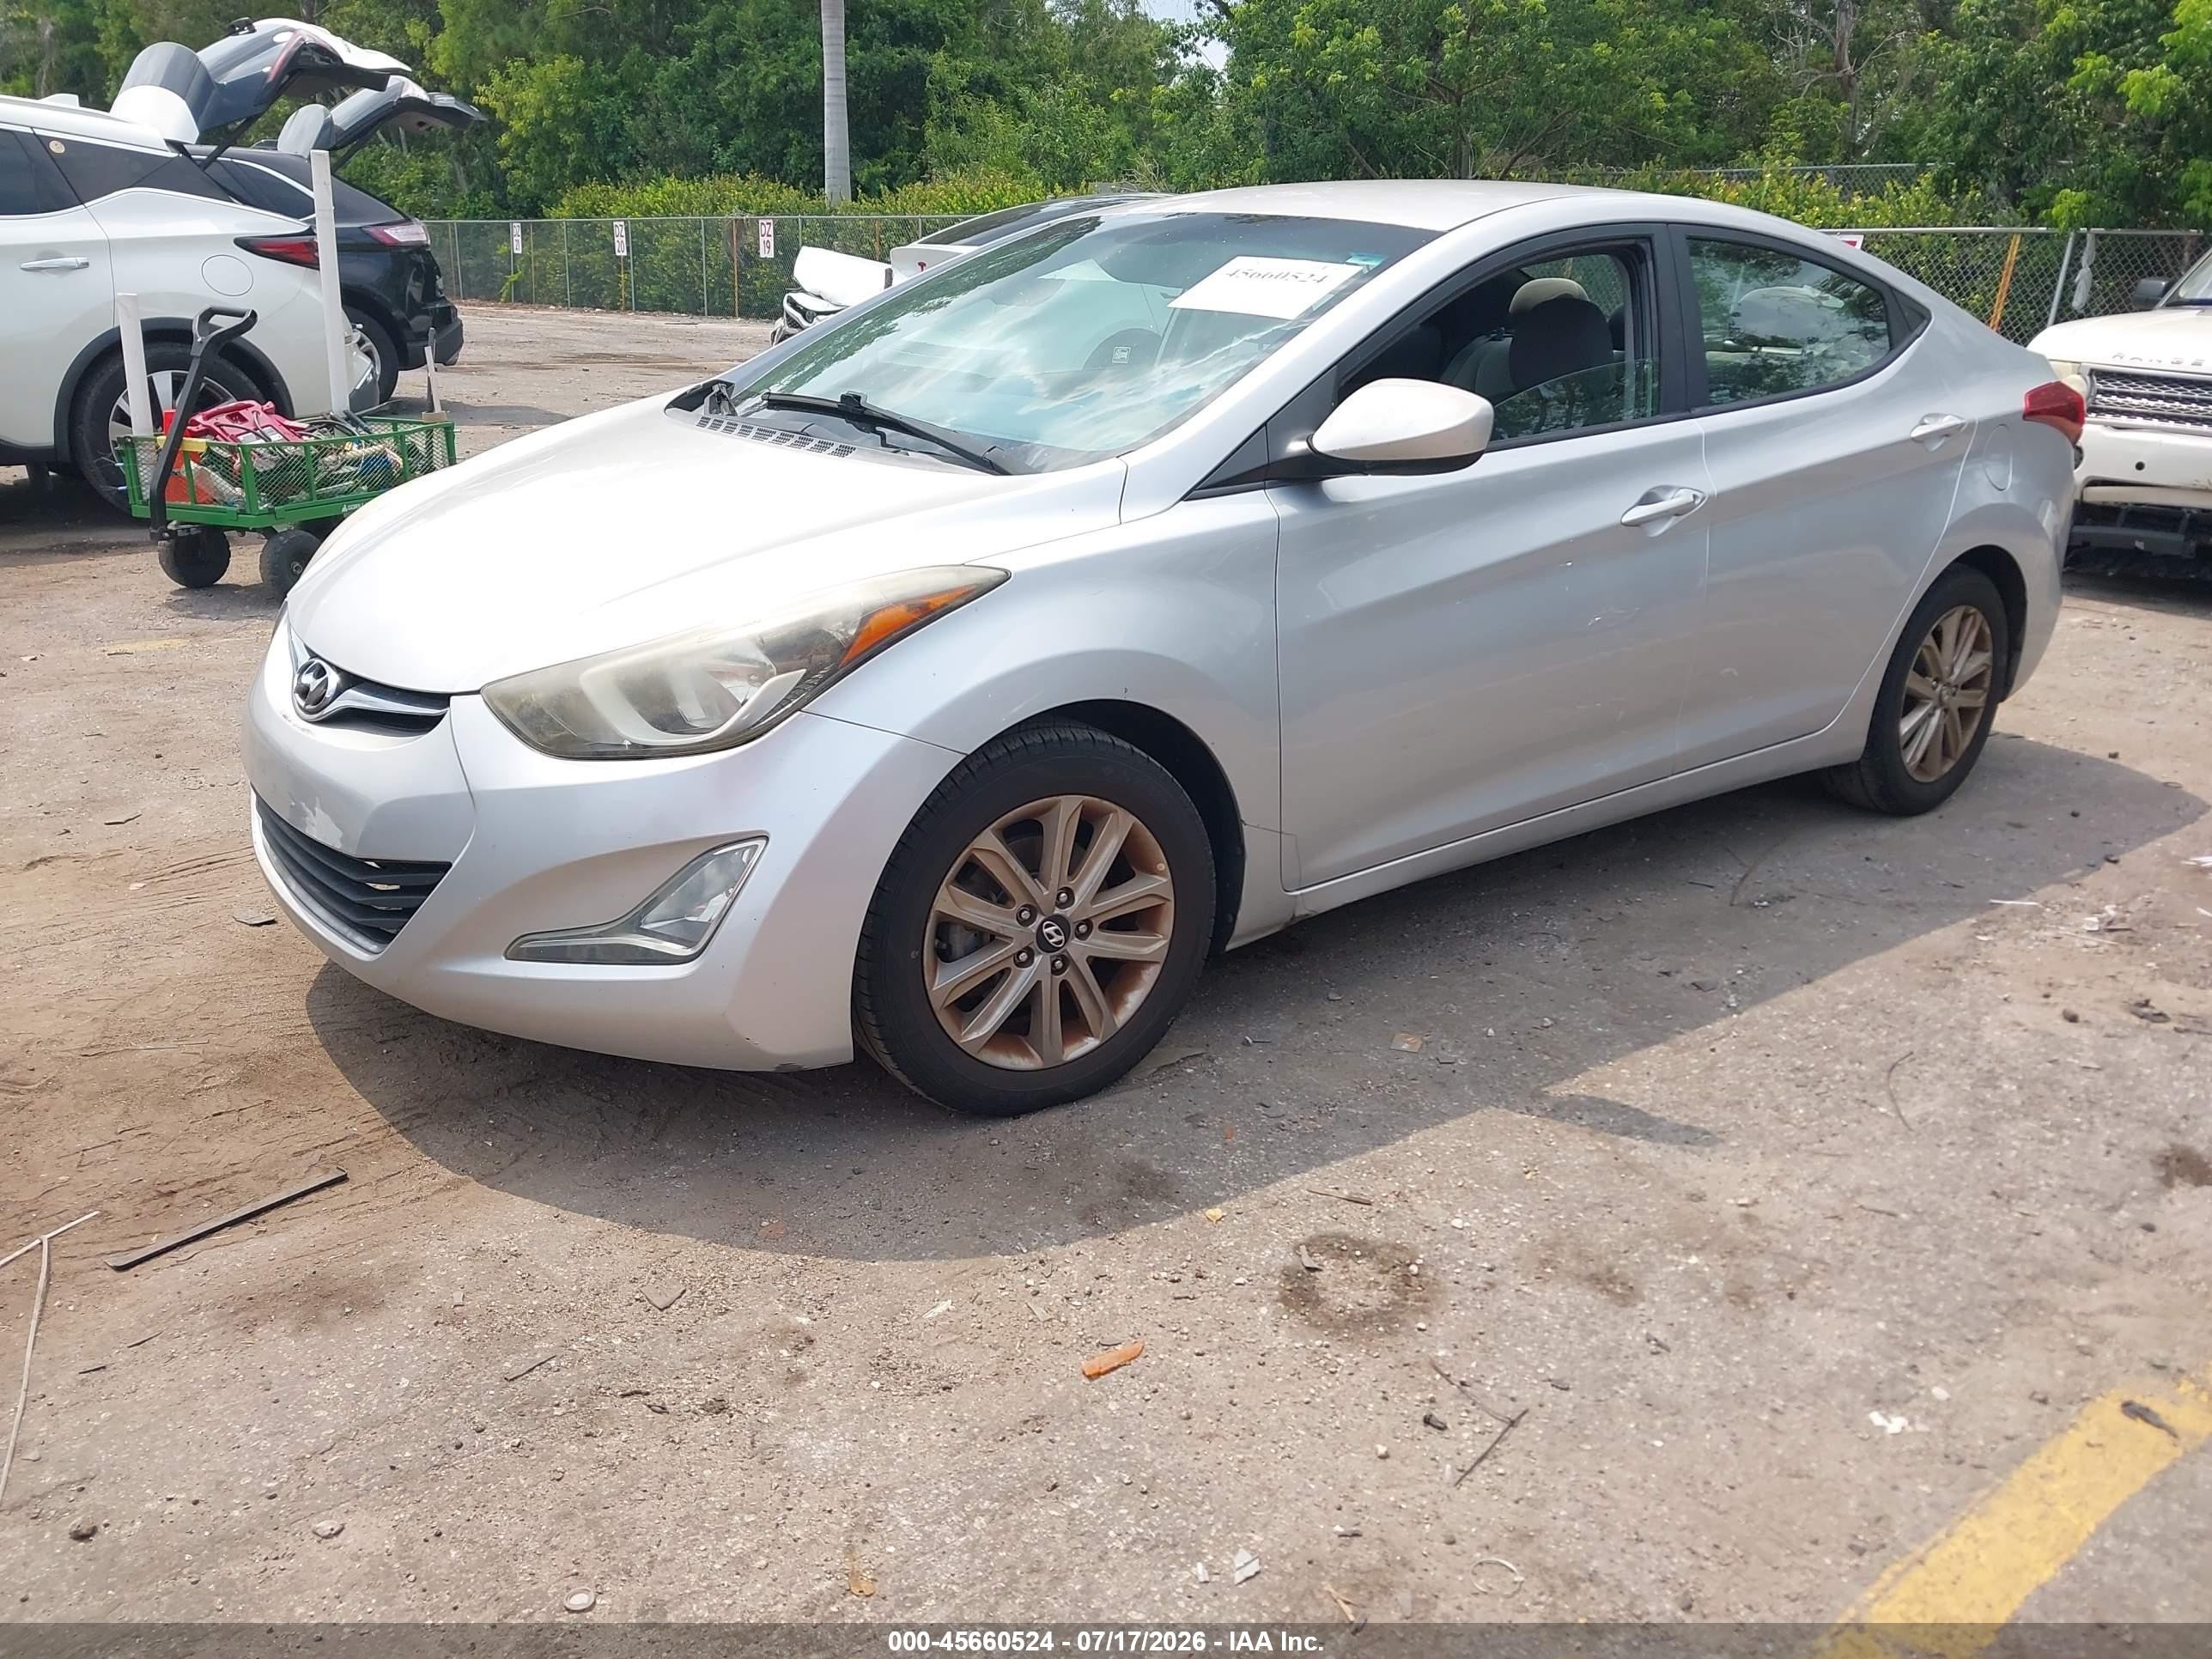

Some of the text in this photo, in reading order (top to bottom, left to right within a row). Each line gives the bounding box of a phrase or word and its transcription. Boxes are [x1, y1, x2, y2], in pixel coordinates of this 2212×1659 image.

[615, 224, 624, 238] DZ
[761, 222, 772, 237] DZ
[617, 240, 625, 253] 20
[763, 240, 771, 255] 19
[1225, 269, 1329, 283] 45660524
[2112, 352, 2206, 367] RANGE
